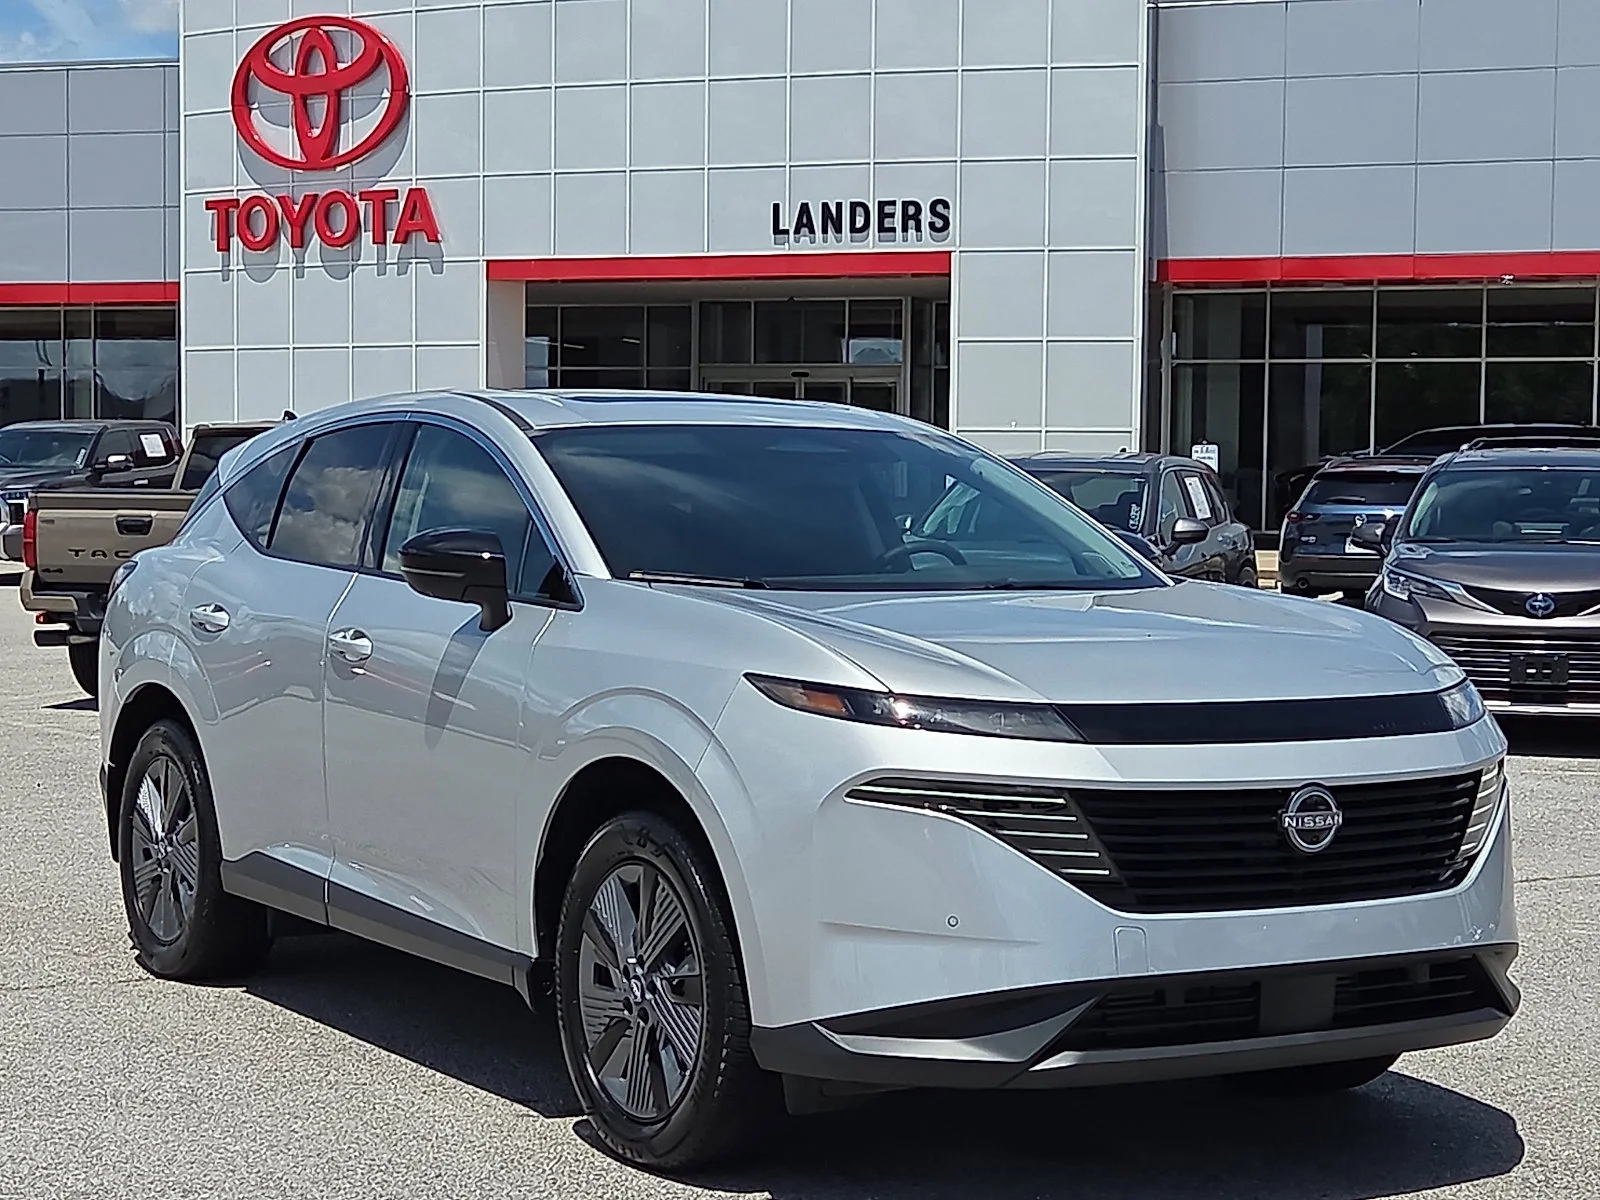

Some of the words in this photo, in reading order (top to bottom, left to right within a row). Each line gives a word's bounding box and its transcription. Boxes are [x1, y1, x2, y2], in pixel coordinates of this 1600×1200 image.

[205, 188, 442, 252] TOYOTA
[772, 198, 951, 238] LANDERS
[1283, 813, 1343, 828] NISSAN
